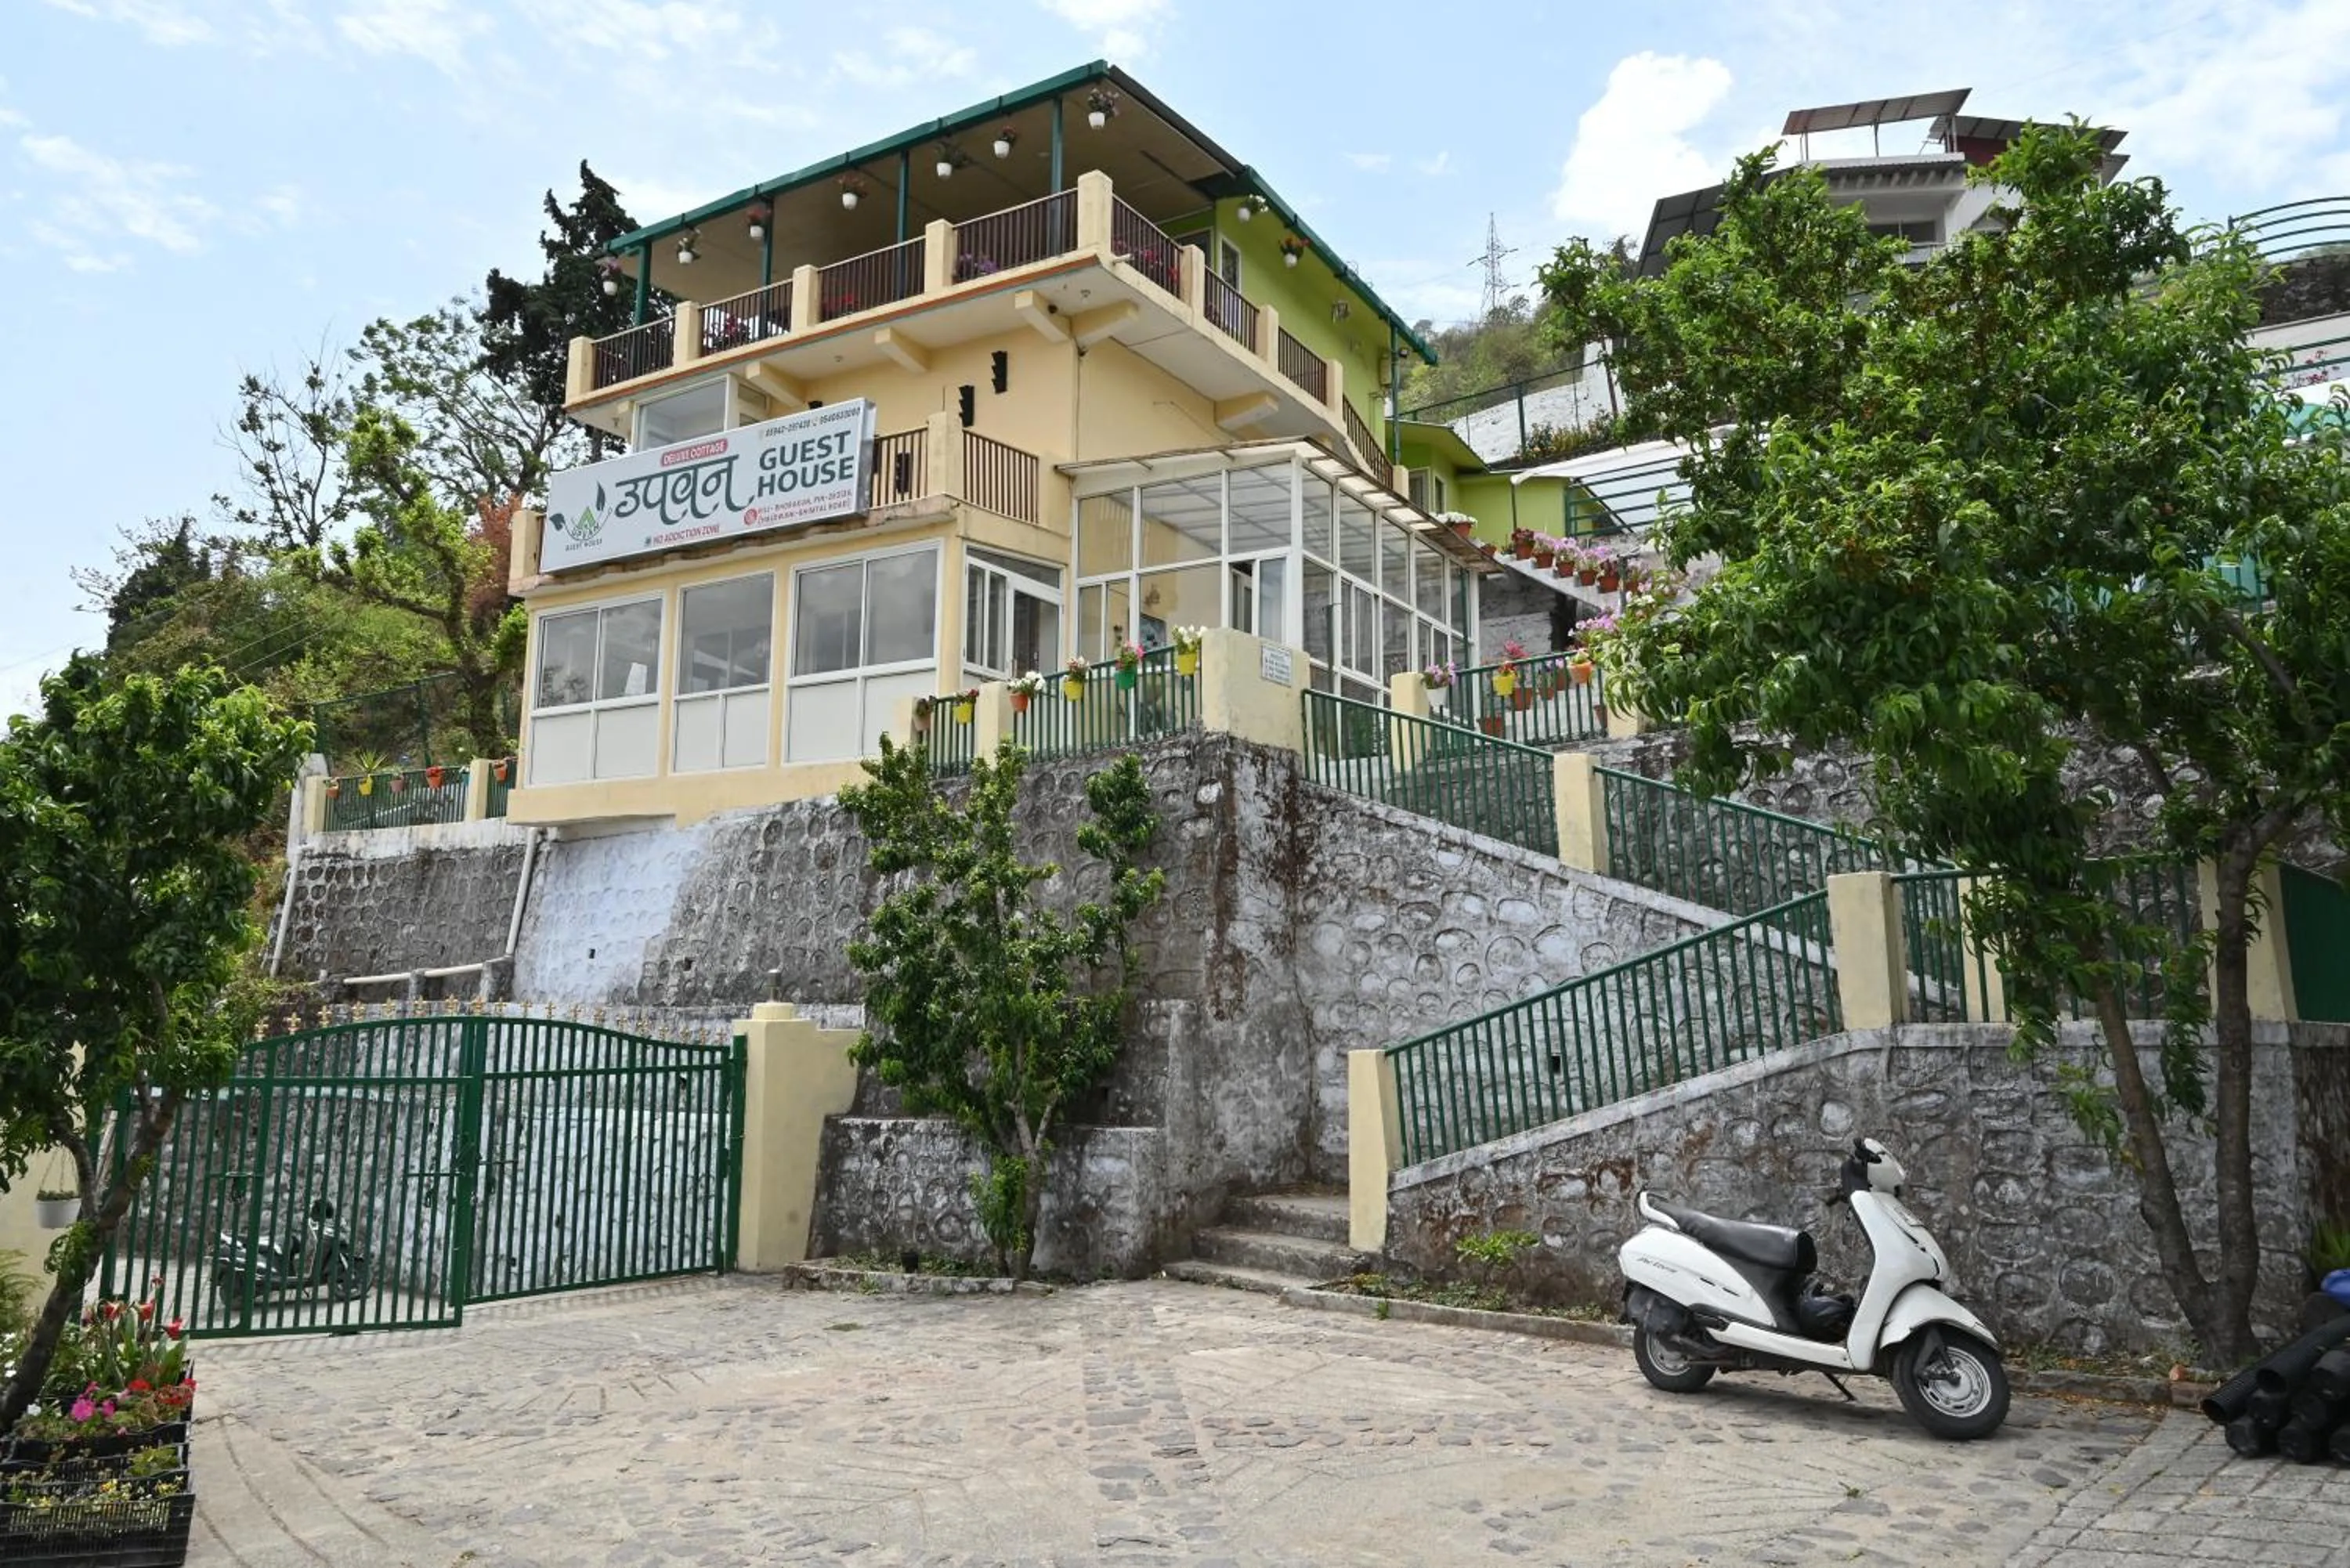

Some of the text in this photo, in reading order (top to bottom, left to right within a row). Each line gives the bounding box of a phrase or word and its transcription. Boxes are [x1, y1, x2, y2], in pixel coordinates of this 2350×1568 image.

[690, 440, 725, 458] COTTAGE
[759, 430, 851, 471] GUEST
[614, 454, 755, 525] उपवन
[757, 456, 855, 497] HOUSE
[653, 524, 720, 544] NO ADDICTION ZONE
